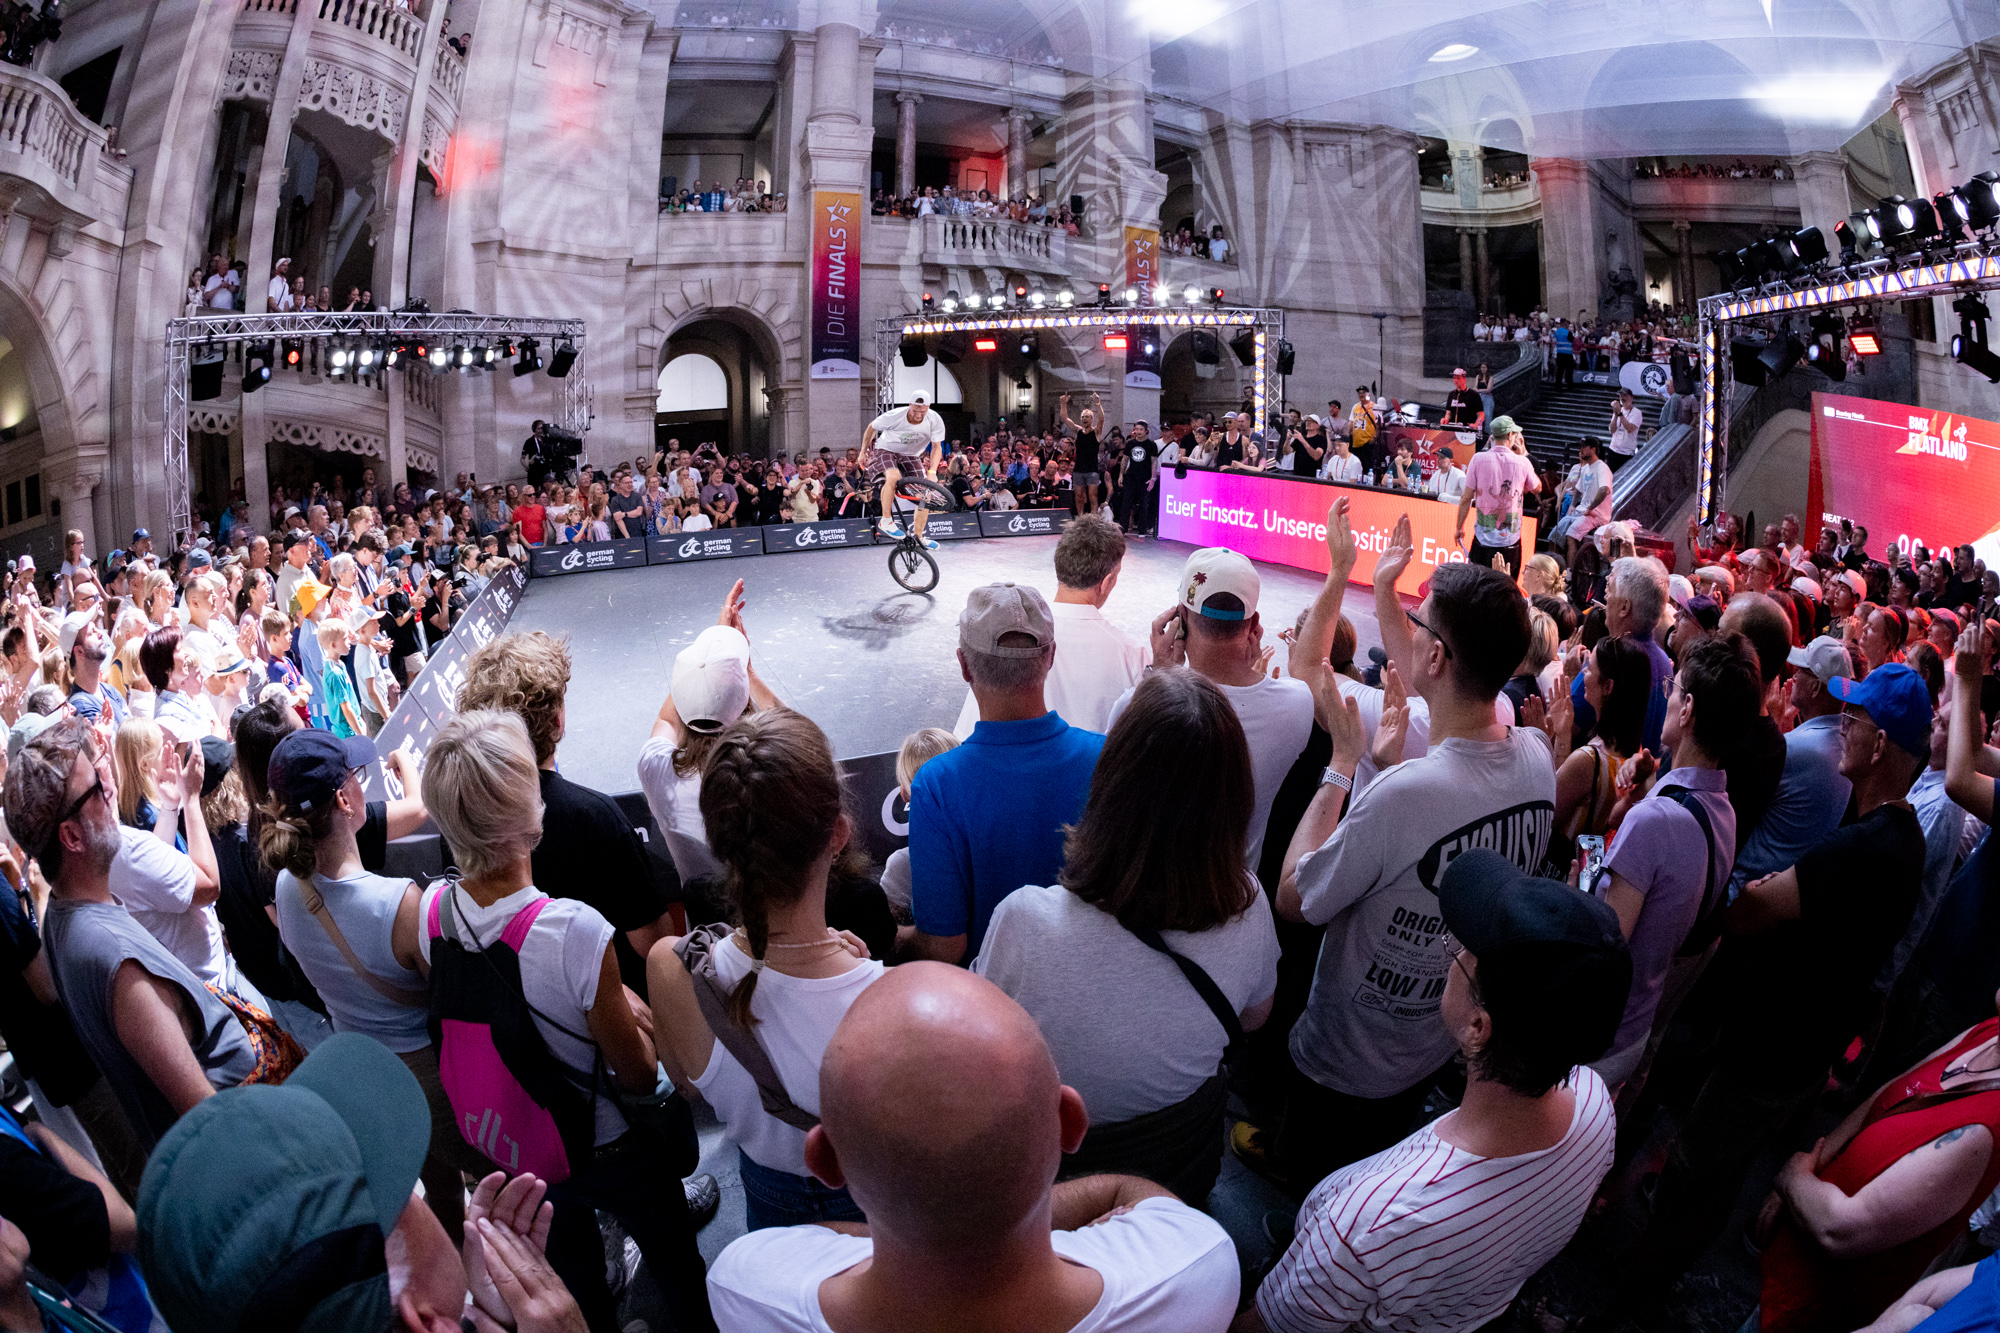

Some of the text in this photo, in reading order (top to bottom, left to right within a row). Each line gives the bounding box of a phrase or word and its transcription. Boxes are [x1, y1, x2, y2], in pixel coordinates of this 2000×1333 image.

[828, 226, 847, 299] FINALS
[827, 302, 846, 336] DIE
[1908, 415, 1929, 432] BMX
[1908, 432, 1967, 461] FLATLAND
[1822, 512, 1842, 525] HEAT
[819, 528, 846, 536] german
[1165, 494, 1196, 518] Euer
[1200, 499, 1259, 529] Einsatz.
[1263, 508, 1327, 542] Unsere
[1421, 536, 1470, 566] Ene
[704, 538, 732, 546] german
[704, 544, 731, 552] cycling
[586, 549, 615, 558] german
[586, 555, 613, 564] cycling
[1386, 924, 1436, 948] ONLY
[1374, 952, 1399, 969] HIGH
[1364, 960, 1420, 998] LOW
